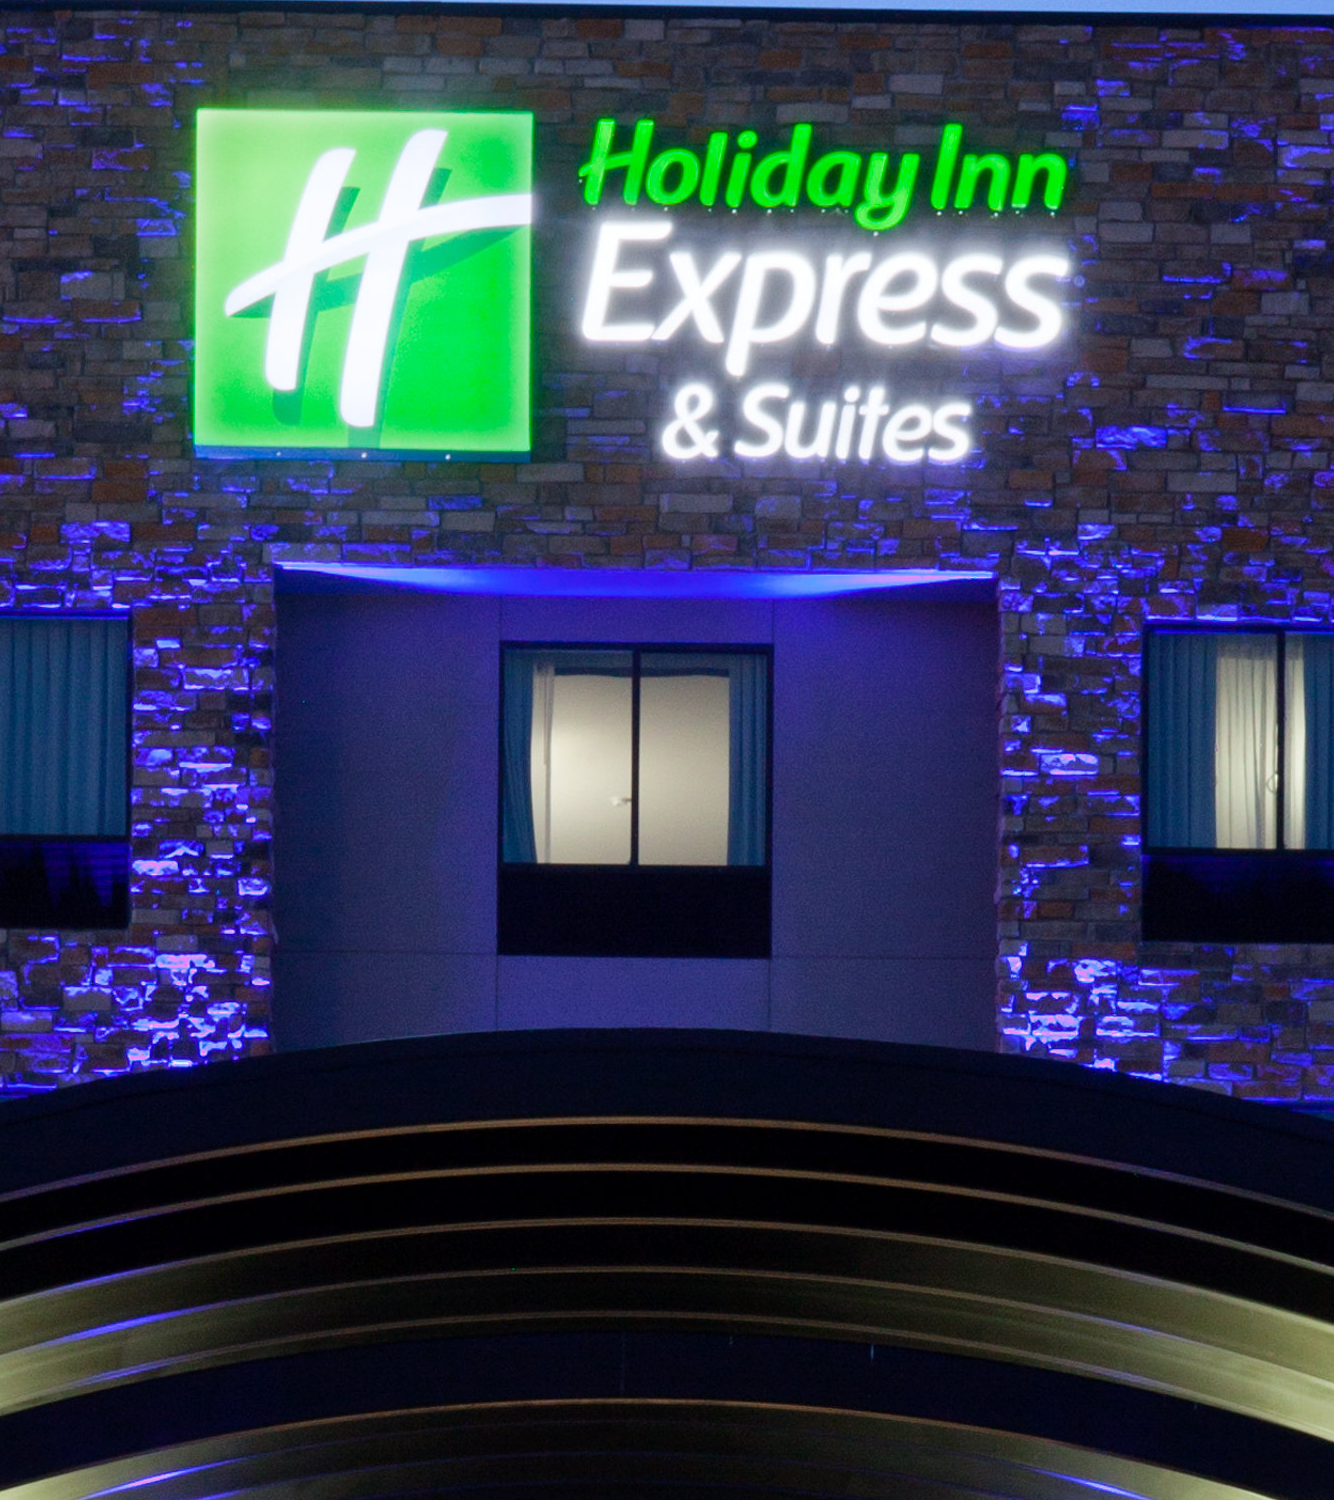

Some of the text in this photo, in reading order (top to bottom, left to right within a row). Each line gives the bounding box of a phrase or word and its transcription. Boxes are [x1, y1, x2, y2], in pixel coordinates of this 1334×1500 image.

[578, 118, 1068, 231] Holiday Inn
[224, 128, 532, 428] H
[581, 220, 1070, 377] Express
[662, 383, 973, 463] & Suites
